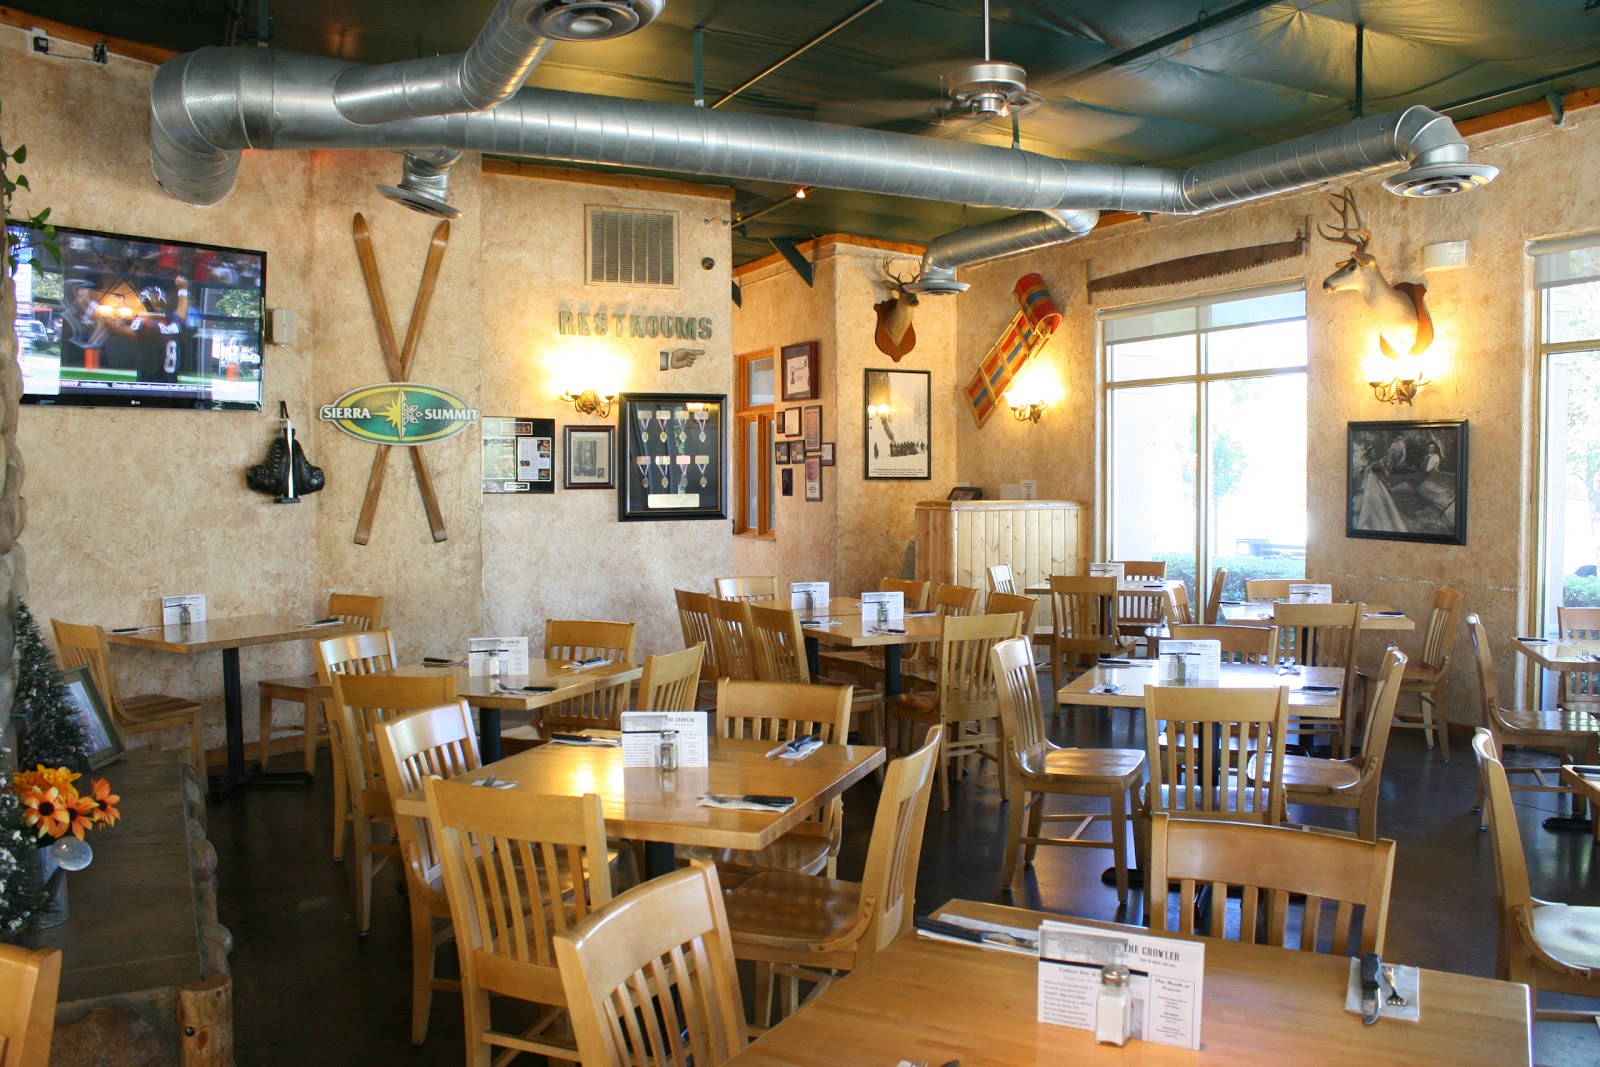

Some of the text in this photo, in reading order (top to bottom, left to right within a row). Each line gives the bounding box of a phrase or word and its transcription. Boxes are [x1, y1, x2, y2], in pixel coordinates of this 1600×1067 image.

[558, 311, 713, 340] RESTROOMS
[164, 340, 177, 373] 8
[323, 407, 479, 420] SIERRA SUMMIT
[1123, 943, 1180, 961] THE GROWLER
